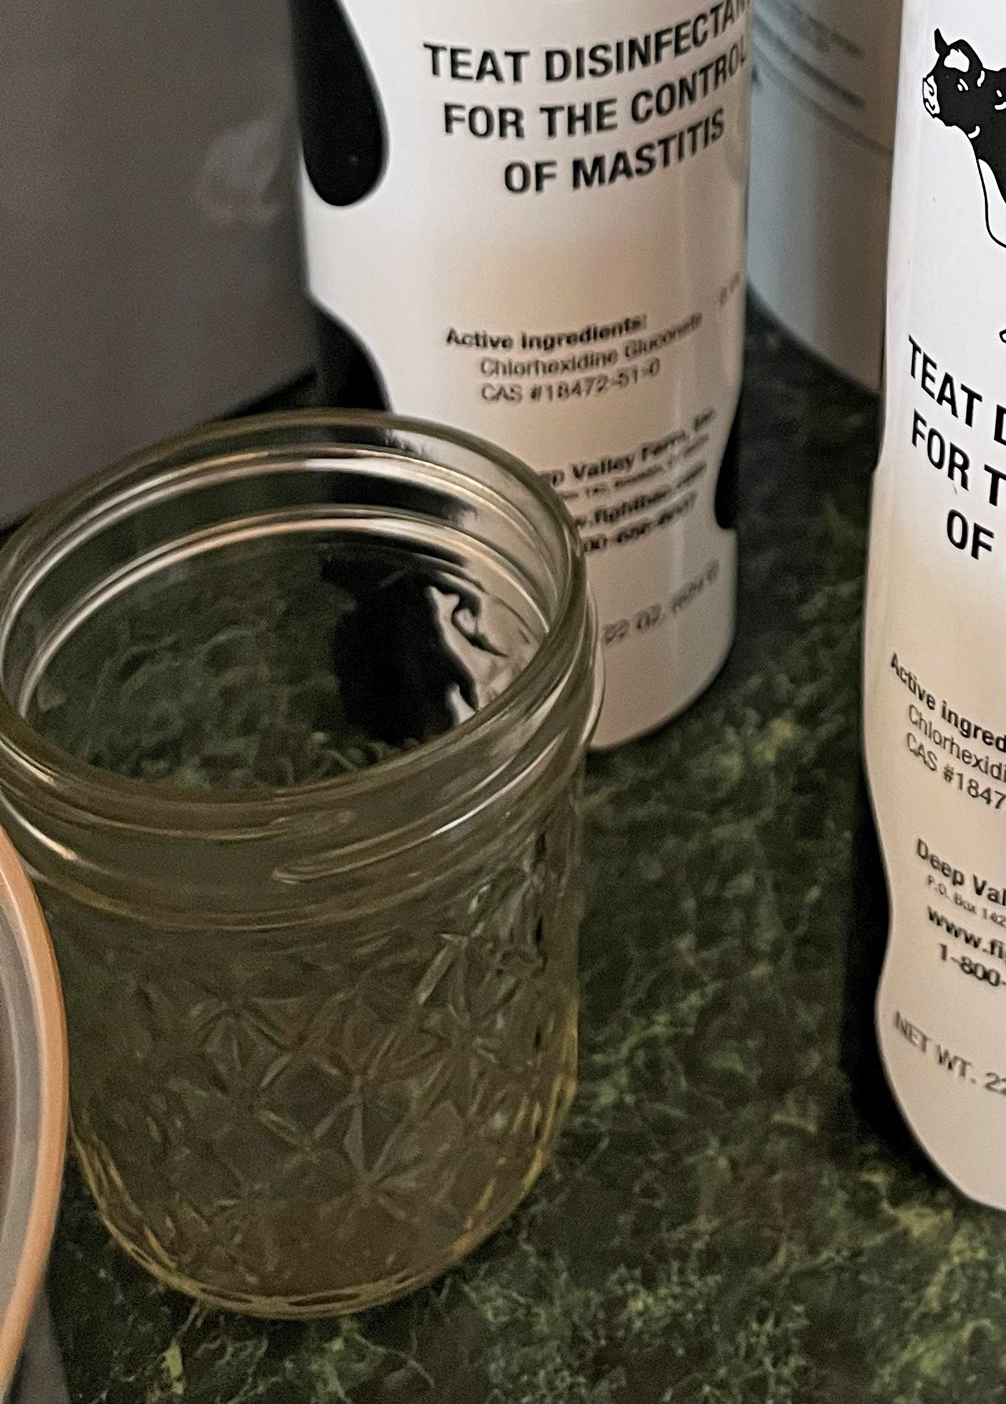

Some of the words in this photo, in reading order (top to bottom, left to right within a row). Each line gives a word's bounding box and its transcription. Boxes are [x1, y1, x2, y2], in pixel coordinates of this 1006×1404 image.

[423, 42, 530, 84] TEAT
[444, 102, 525, 139] FOR
[539, 98, 618, 137] THE
[504, 161, 557, 193] OF
[572, 108, 724, 190] MASTITIS
[446, 327, 514, 350] Active
[479, 351, 618, 378] Chlorhexidine
[908, 334, 983, 428] TEAT
[481, 383, 523, 403] CAS
[911, 409, 971, 492] FOR
[946, 508, 995, 560] OF
[890, 652, 936, 711] Active
[906, 732, 939, 772] CAS
[916, 838, 965, 887] Deep
[895, 1010, 930, 1054] NET
[935, 1045, 976, 1084] WT.
